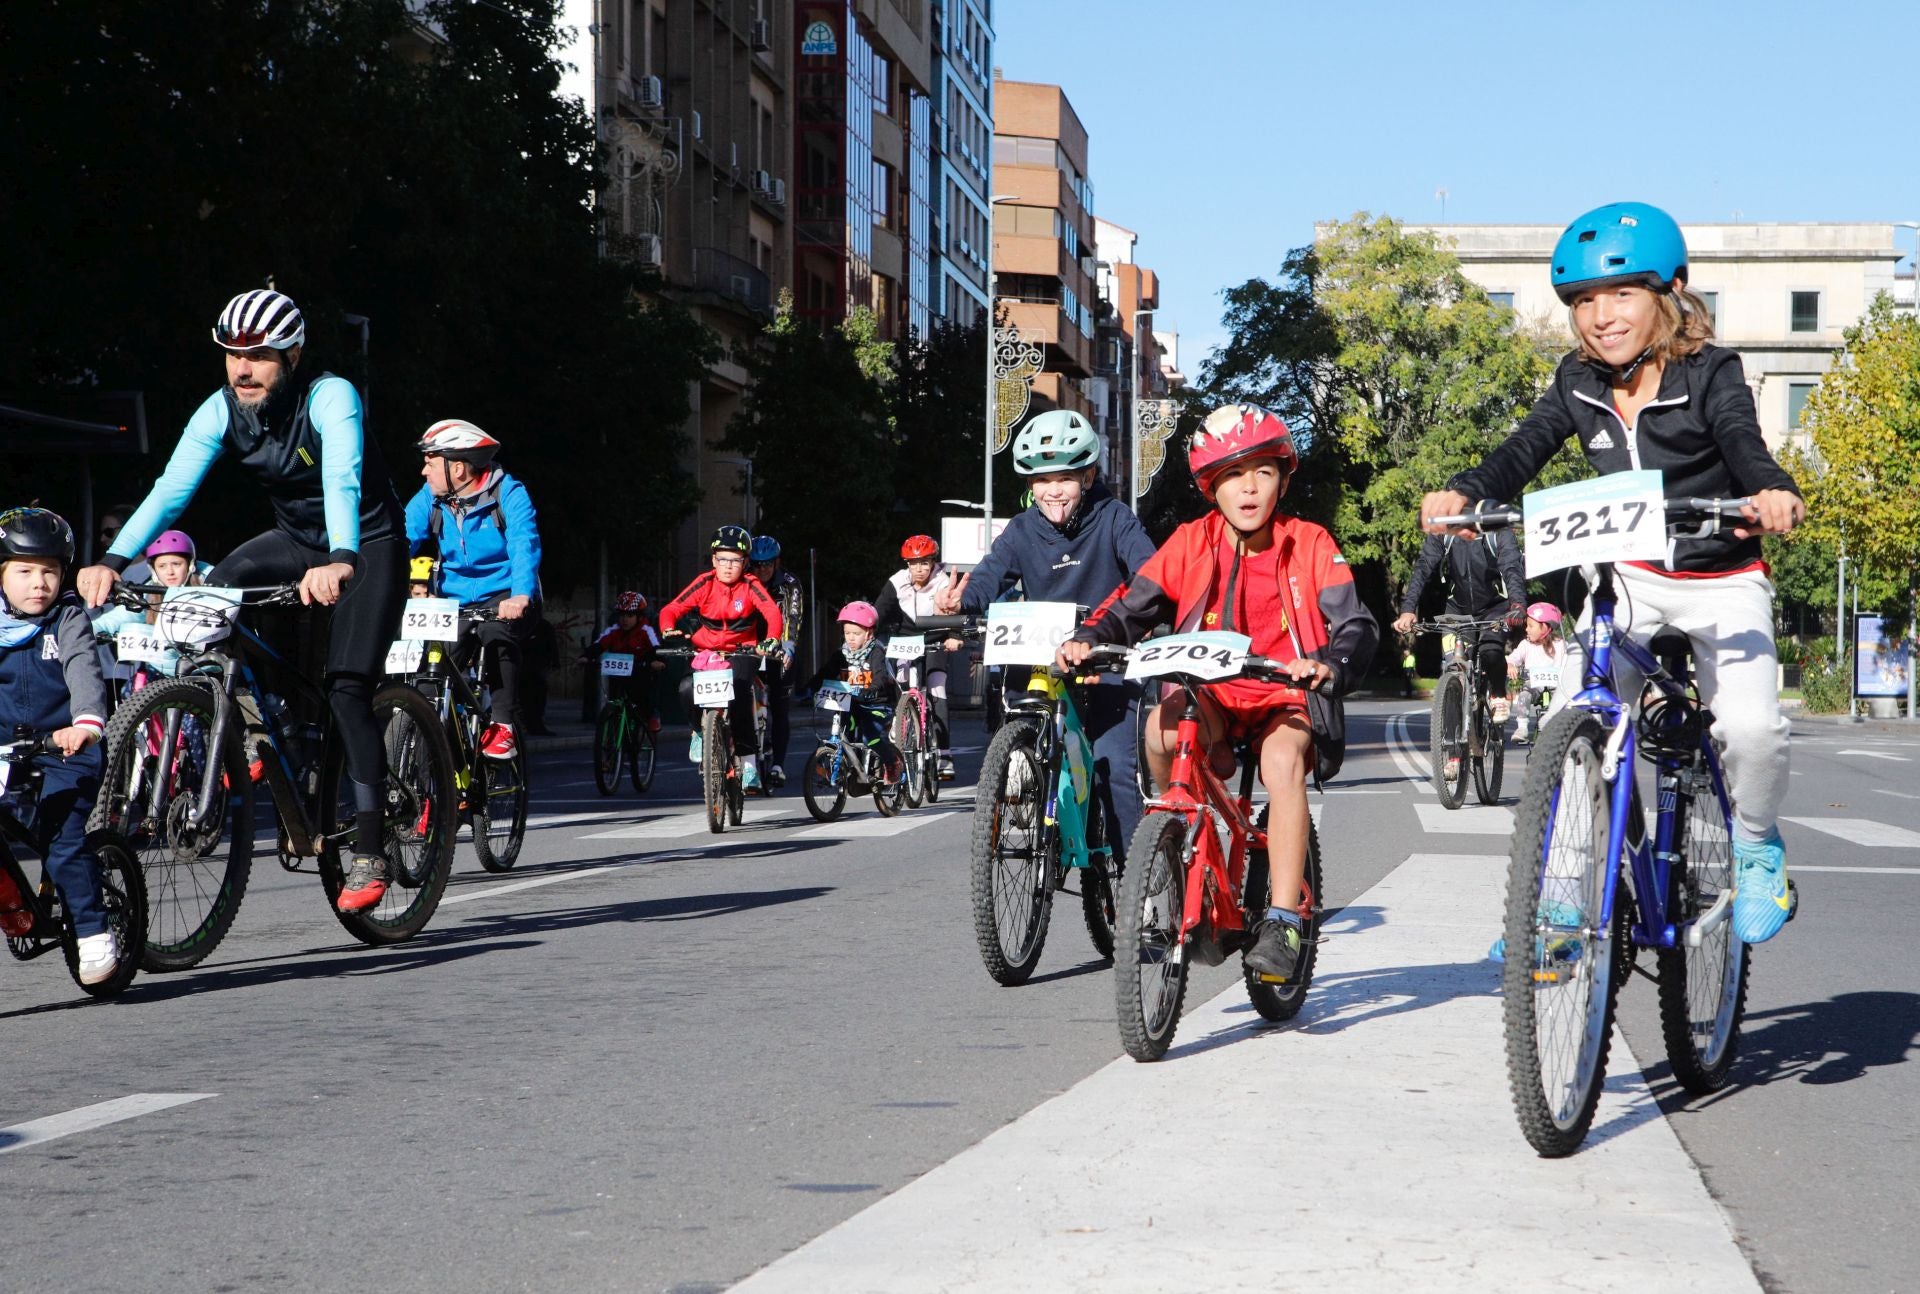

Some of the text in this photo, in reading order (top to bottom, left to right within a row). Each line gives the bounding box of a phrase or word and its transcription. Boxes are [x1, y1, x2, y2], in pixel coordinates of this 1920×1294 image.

[804, 42, 836, 52] ANPE
[1539, 501, 1648, 546] 3217
[408, 613, 452, 628] 3243
[993, 624, 1064, 647] 2140
[42, 634, 59, 660] A
[120, 636, 160, 652] 3244
[1140, 644, 1232, 668] 2704
[604, 661, 630, 670] 3581
[696, 681, 730, 694] 0517
